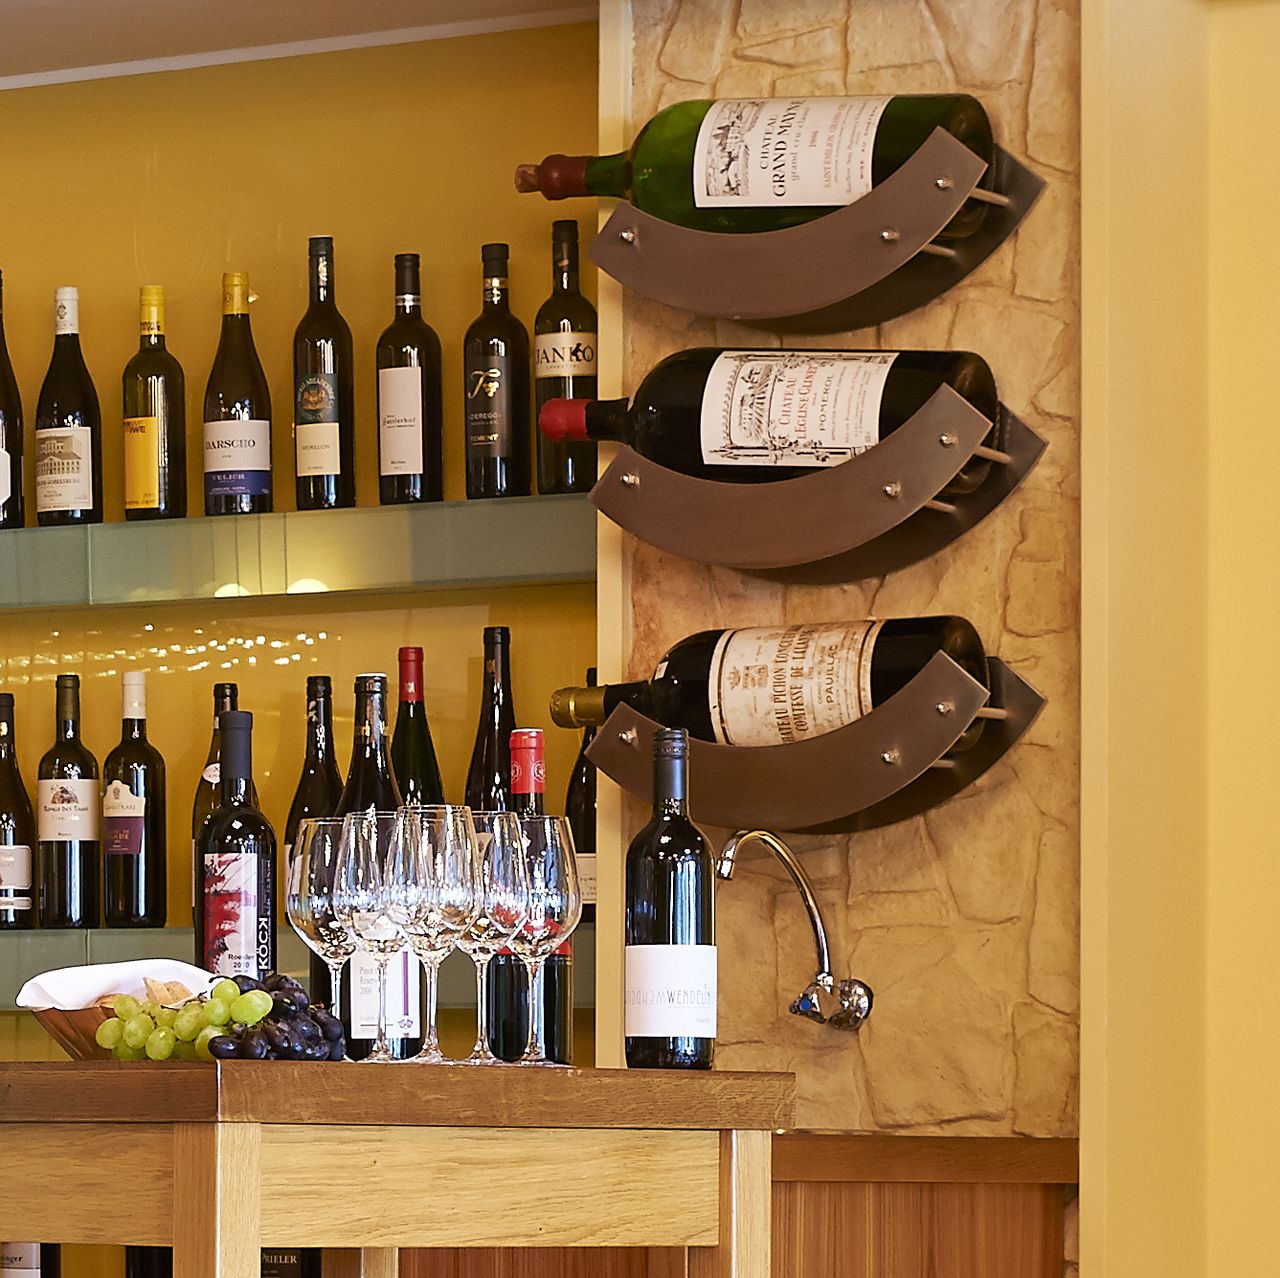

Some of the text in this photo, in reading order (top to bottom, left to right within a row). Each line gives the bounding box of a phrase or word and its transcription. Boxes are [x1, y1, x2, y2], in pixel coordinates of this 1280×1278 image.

[760, 114, 779, 170] CHATEAU
[793, 132, 802, 148] cru
[772, 140, 787, 198] GRAND
[790, 152, 800, 182] grand
[536, 343, 594, 365] JANKO
[772, 668, 787, 704] PICHON
[790, 666, 804, 678] DE
[825, 644, 839, 704] PAUILLAC
[790, 685, 809, 732] COMTESSE
